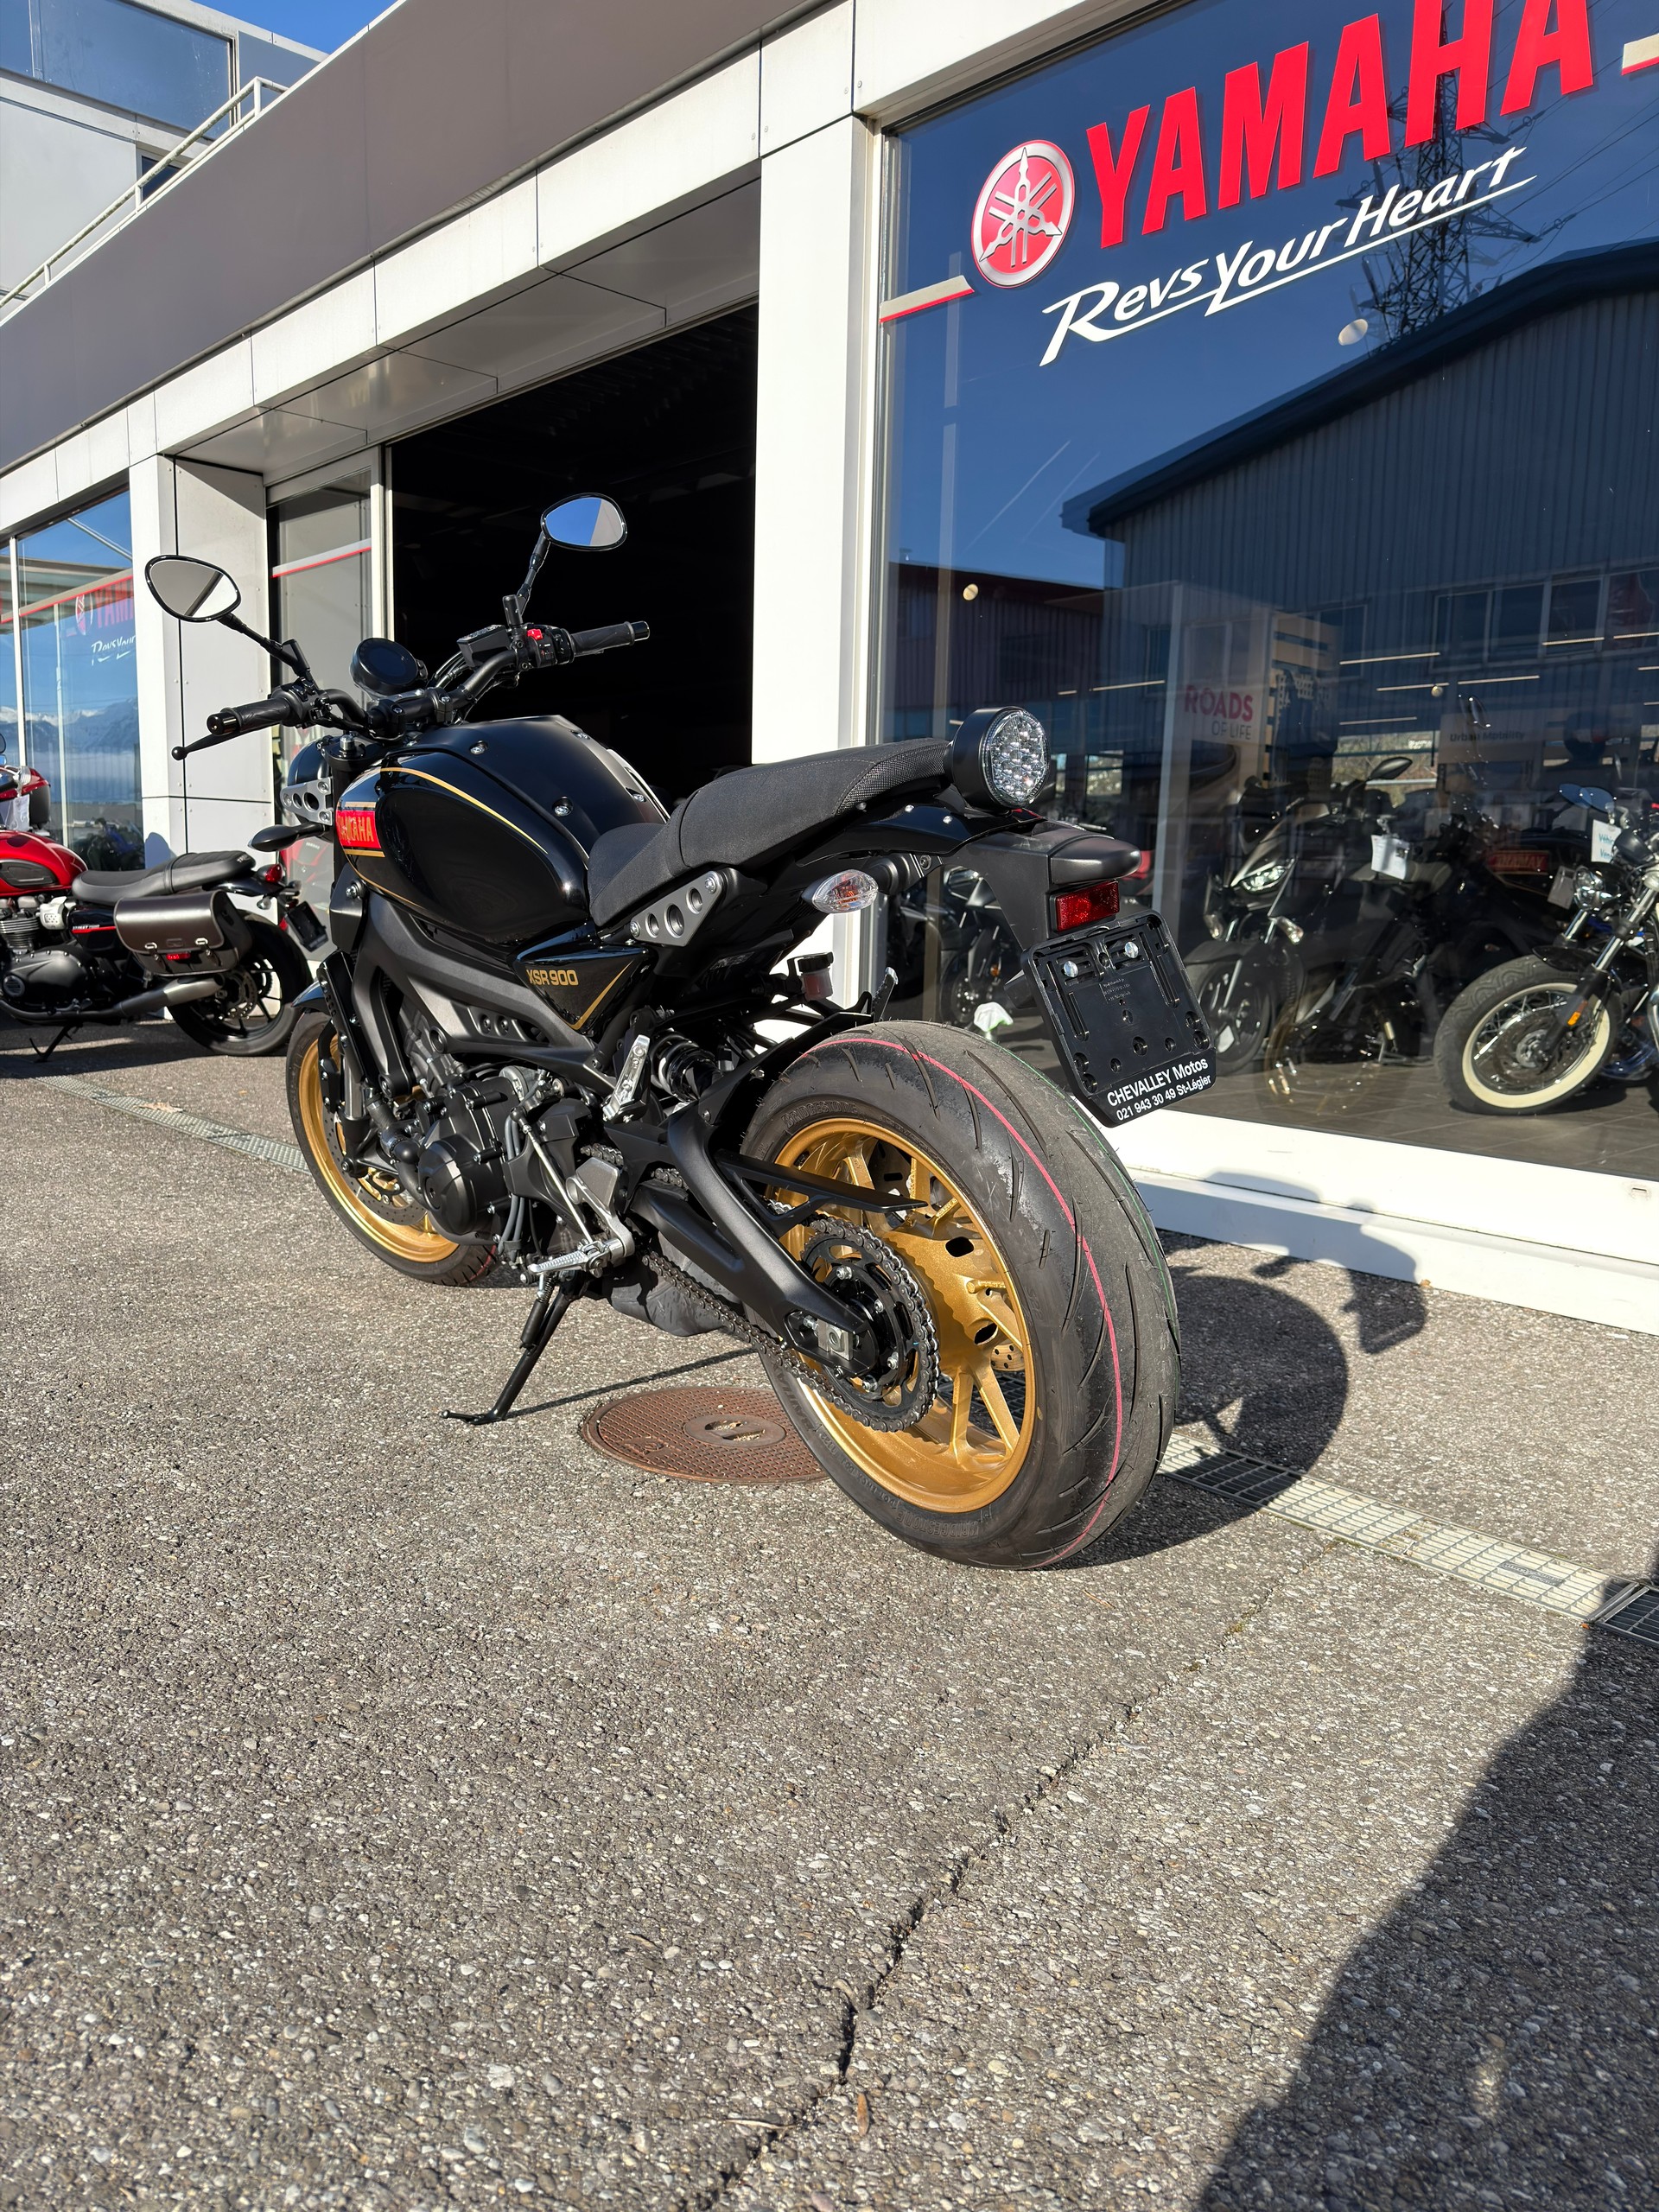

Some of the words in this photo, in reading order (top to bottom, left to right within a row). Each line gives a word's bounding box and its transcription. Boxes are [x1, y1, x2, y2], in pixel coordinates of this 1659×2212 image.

[1087, 0, 1593, 249] YAMAHA
[1039, 258, 1211, 366] Revs
[1205, 216, 1350, 316] Your
[1344, 146, 1528, 247] Heart
[1185, 684, 1253, 722] ROADS
[1211, 721, 1227, 736] OF
[1230, 725, 1252, 740] LIFE
[1450, 733, 1480, 741] Urban
[1483, 730, 1526, 741] Mobility
[1107, 1069, 1172, 1106] CHEVALLEY
[1172, 1058, 1208, 1081] Motos
[1116, 1106, 1134, 1121] 021
[1134, 1098, 1152, 1113] 943
[1152, 1093, 1164, 1105] 30
[1165, 1090, 1176, 1100] 49
[1176, 1075, 1211, 1096] St-Légier
[781, 1100, 858, 1128] BRIDGESTONE
[896, 1511, 978, 1537] BRIDGESTONE
